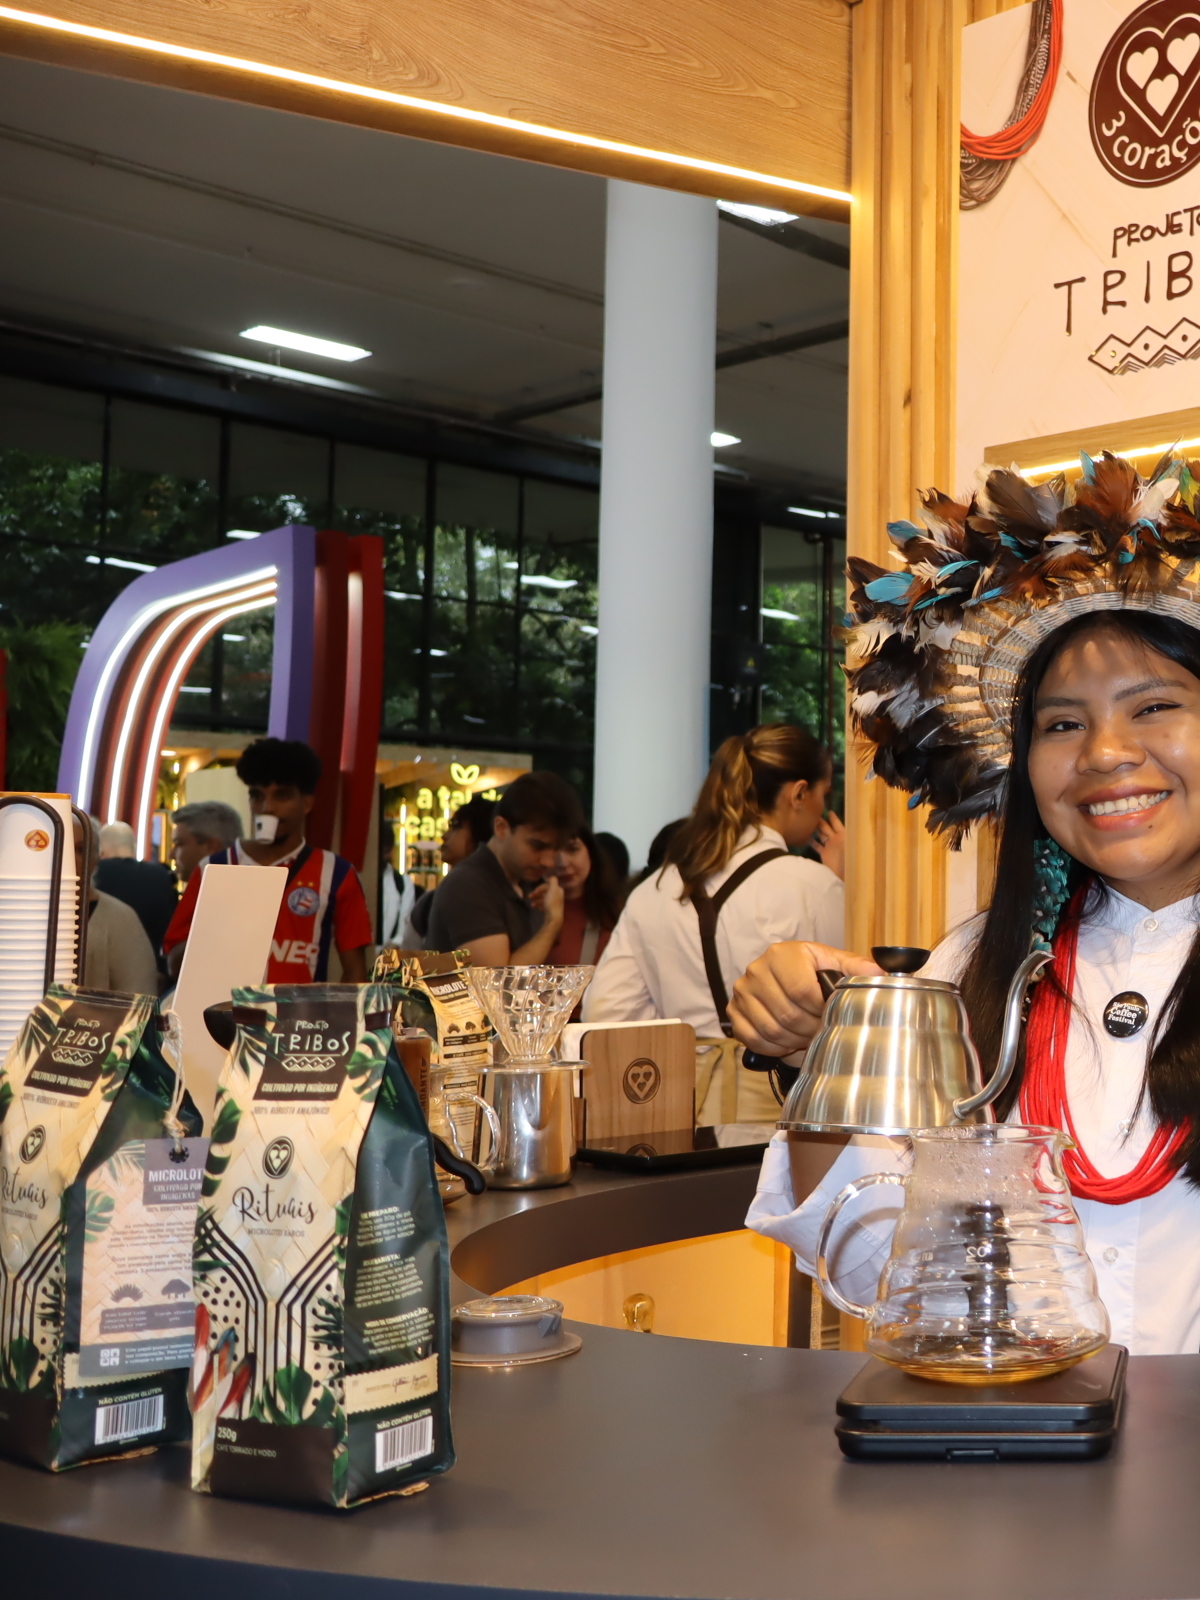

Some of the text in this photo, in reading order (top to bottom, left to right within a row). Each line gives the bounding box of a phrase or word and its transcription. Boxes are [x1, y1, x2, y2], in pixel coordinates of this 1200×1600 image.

[1101, 111, 1126, 136] 3
[1108, 1014, 1135, 1025] Festival
[1110, 1008, 1137, 1018] Coffee
[295, 1020, 329, 1031] PROJETO
[53, 1028, 112, 1054] TRIBOS
[272, 1031, 351, 1056] TRIBOS
[262, 1082, 338, 1092] CULTIVADO POR INDÍGENAS
[270, 1106, 296, 1114] ROBUSTA
[149, 1168, 204, 1182] MICROLOT
[232, 1183, 318, 1224] Rituais
[386, 1307, 429, 1324] CONSERVAÇÃO:
[98, 1387, 162, 1406] NÃO CONTÉM GLÚTEN
[376, 1408, 431, 1430] NÃO CONTÉM GLÚTEN
[217, 1426, 237, 1442] 250g
[229, 1445, 252, 1455] TORRADO
[253, 1448, 257, 1456] E
